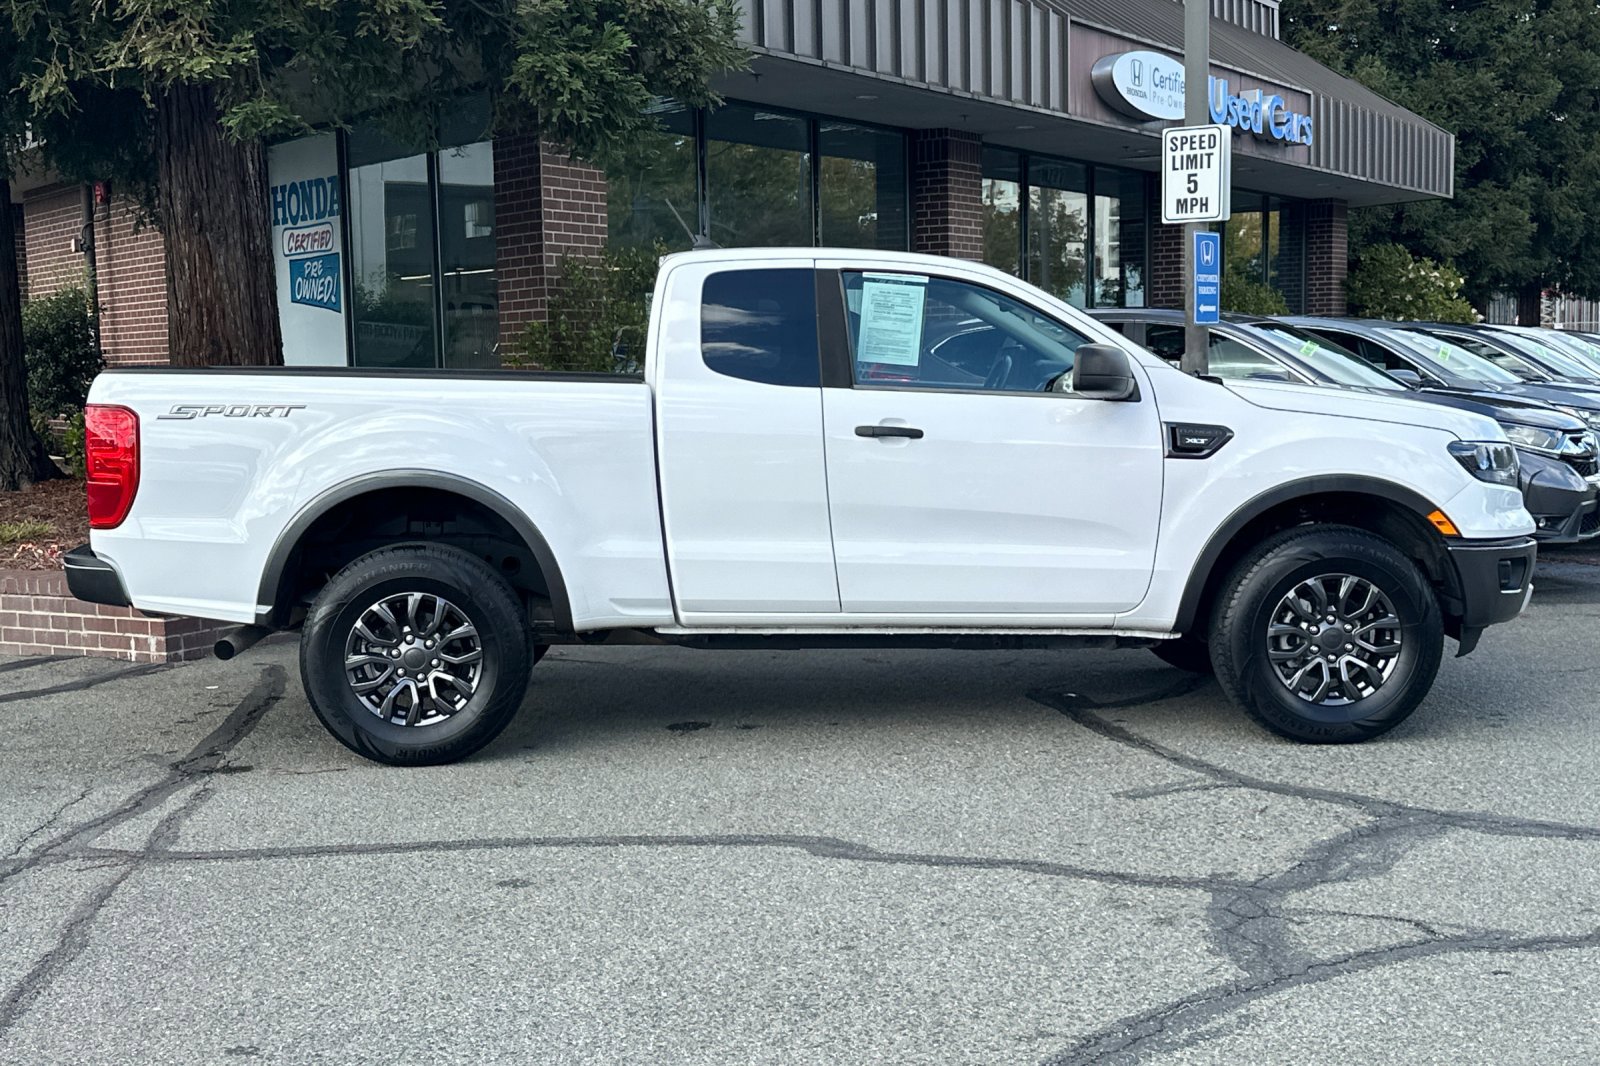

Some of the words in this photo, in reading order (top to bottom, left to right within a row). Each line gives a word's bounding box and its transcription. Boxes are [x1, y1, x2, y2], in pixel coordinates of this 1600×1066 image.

[1153, 67, 1185, 94] Certifie
[1126, 87, 1148, 99] HONDA
[1208, 75, 1263, 134] Used
[1268, 95, 1313, 146] Cars
[1170, 134, 1216, 152] SPEED
[1172, 152, 1214, 171] LIMIT
[1187, 173, 1198, 194] 5
[271, 175, 340, 226] HONDA
[1176, 197, 1208, 214] MPH
[287, 229, 331, 253] CERTIFIED
[304, 260, 323, 277] PRE
[295, 273, 338, 304] OWNED!
[156, 404, 307, 420] SPORT
